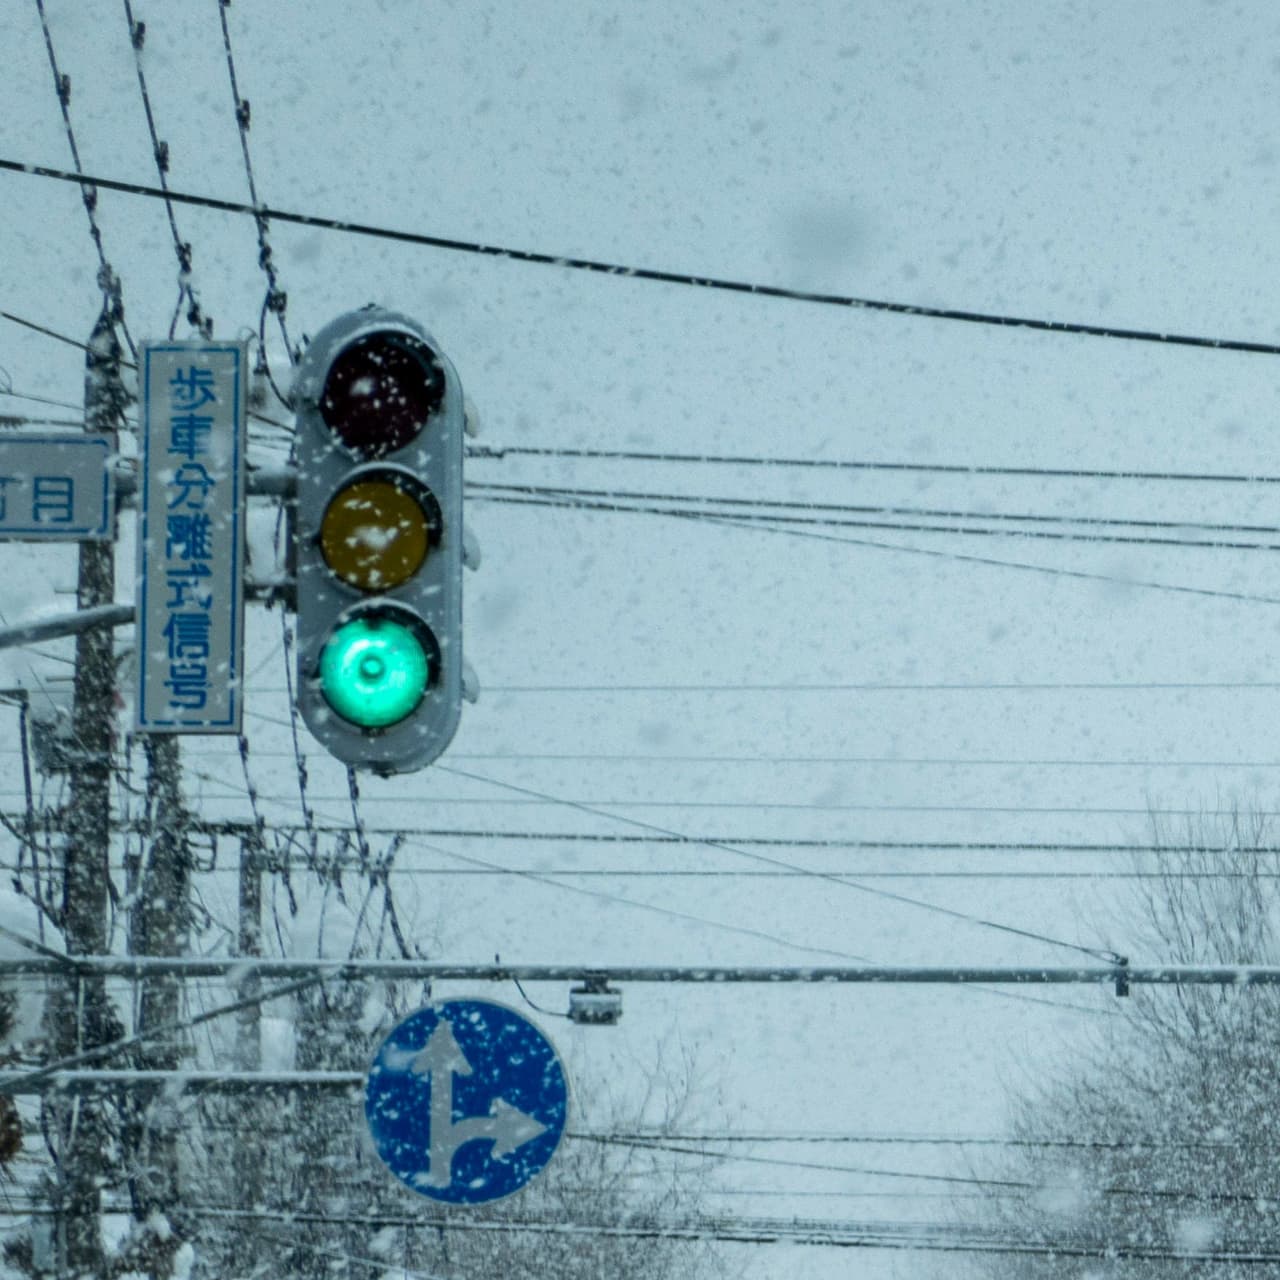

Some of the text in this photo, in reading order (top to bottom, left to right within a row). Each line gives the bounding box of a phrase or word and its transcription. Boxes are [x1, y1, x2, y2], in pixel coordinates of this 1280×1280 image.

[163, 363, 216, 711] 歩車分離式信号
